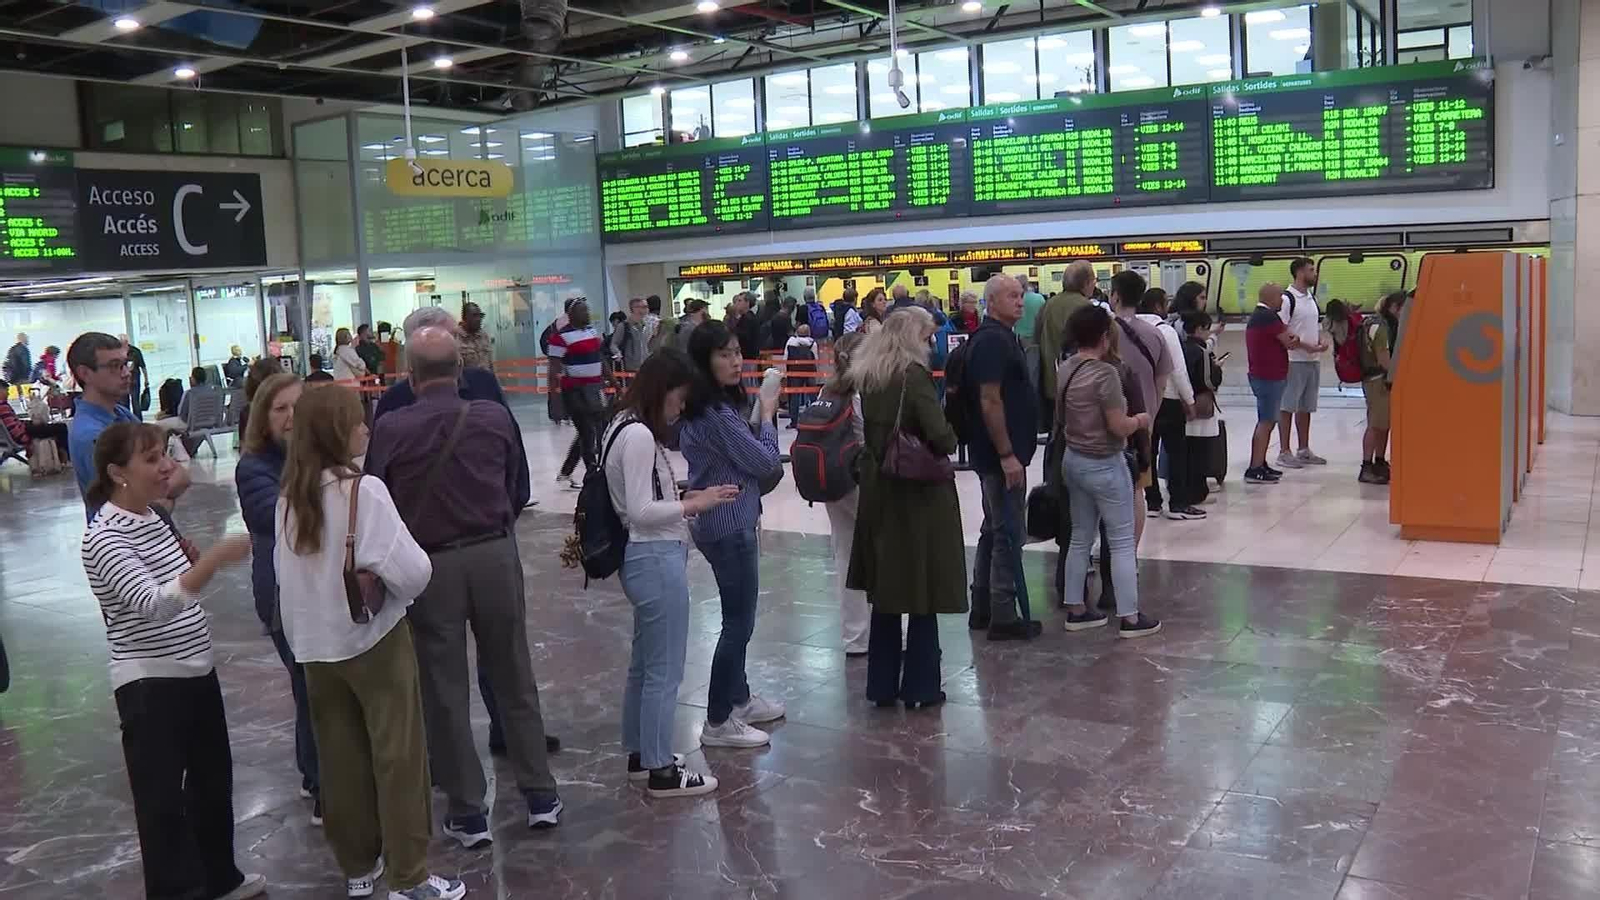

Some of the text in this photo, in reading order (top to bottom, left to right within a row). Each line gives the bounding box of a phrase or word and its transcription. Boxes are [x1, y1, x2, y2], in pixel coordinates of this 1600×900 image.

[1212, 85, 1240, 94] Salidas
[1244, 81, 1277, 90] Sortides
[970, 104, 1027, 117] Salidas Sortides
[1412, 101, 1434, 113] VIES
[1438, 98, 1465, 110] 11-12
[1342, 116, 1378, 128] RODALIA
[1413, 111, 1431, 123] PER
[793, 129, 816, 138] Sortides
[973, 139, 992, 148] 10:41
[993, 135, 1029, 147] BARCELONA
[1079, 128, 1111, 139] RODALIA
[1140, 124, 1158, 134] VIES
[1247, 132, 1294, 145] HOSPITALET
[1324, 129, 1335, 140] R1
[1342, 126, 1378, 138] RODALIA
[1412, 122, 1434, 134] VIES
[1343, 136, 1378, 149] RODALIA
[1412, 132, 1435, 144] VIES
[1439, 130, 1465, 142] 11-12
[1001, 152, 1041, 164] HOSPITALET
[1066, 149, 1075, 158] R1
[1082, 146, 1112, 157] RODALIA
[1140, 142, 1159, 153] VIES
[1027, 143, 1037, 153] LA
[1081, 137, 1111, 148] RODALIA
[1239, 152, 1281, 165] BARCELONA
[1343, 146, 1379, 159] RODALIA
[1413, 142, 1435, 154] VIES
[1001, 161, 1041, 173] HOSPITALET
[1066, 158, 1075, 168] R1
[1082, 155, 1112, 167] RODALIA
[1141, 152, 1159, 162] VIES
[1082, 164, 1112, 176] RODALIA
[1141, 161, 1159, 171] VIES
[1239, 162, 1281, 175] BARCELONA
[1413, 152, 1435, 164] VIES
[412, 167, 491, 188] acerca
[1083, 174, 1113, 185] RODALIA
[1239, 172, 1276, 184] AEROPORT
[1343, 166, 1379, 179] RODALIA
[33, 188, 40, 196] C
[89, 186, 154, 205] Acceso
[995, 189, 1031, 199] BARCELONA
[1083, 183, 1113, 194] RODALIA
[1141, 180, 1160, 190] VIES
[104, 214, 158, 234] Accés
[173, 184, 208, 255] C
[9, 228, 58, 236] VIA MADRID
[120, 244, 160, 256] ACCESS
[779, 283, 785, 291] 2
